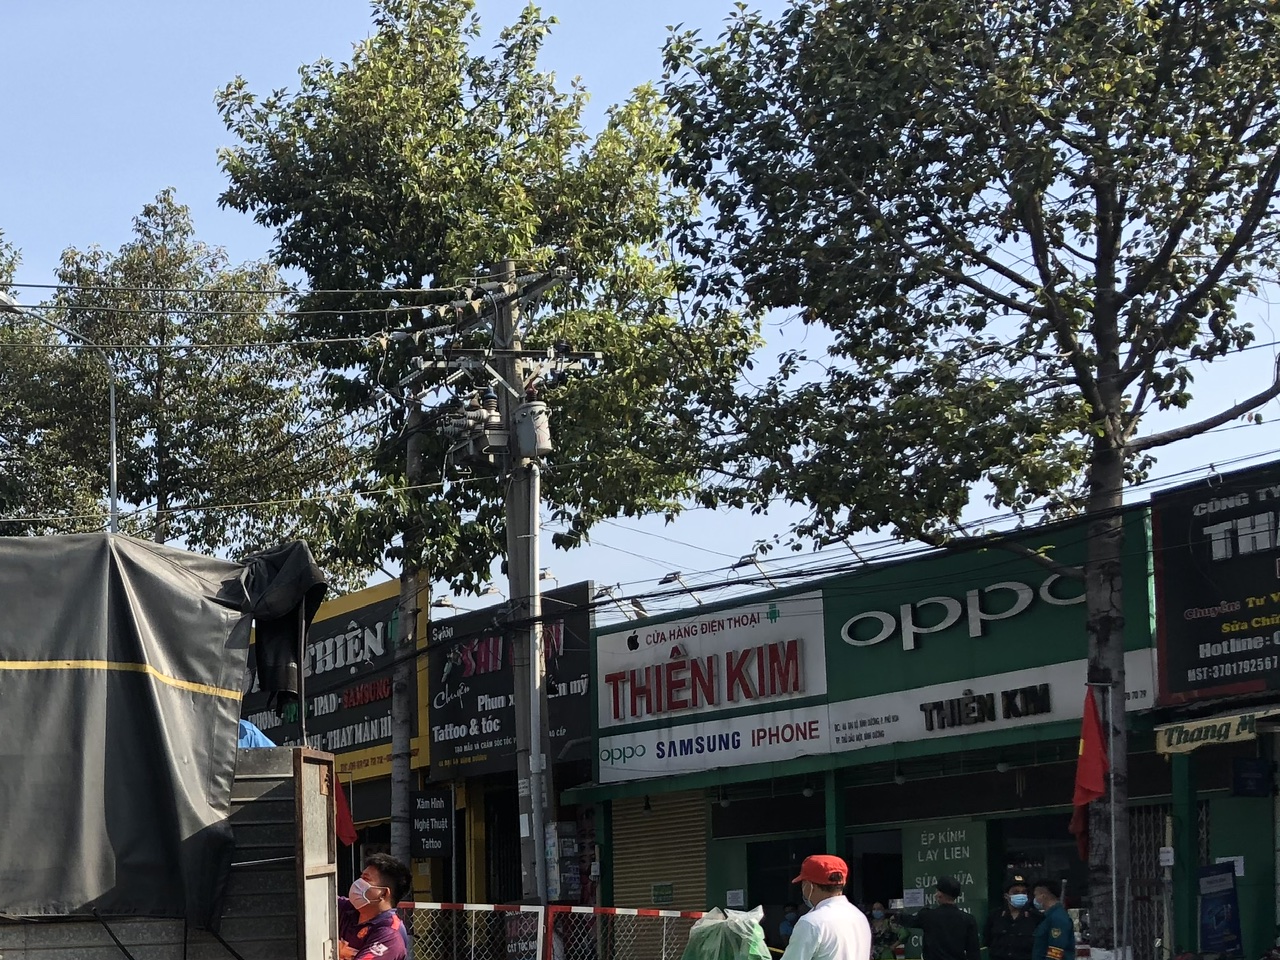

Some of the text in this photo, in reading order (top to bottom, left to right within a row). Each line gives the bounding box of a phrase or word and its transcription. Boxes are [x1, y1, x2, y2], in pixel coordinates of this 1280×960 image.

[1202, 511, 1280, 561] TH
[303, 620, 385, 677] THIỆN
[646, 612, 760, 646] CỬA HÀNG ĐIỆN THOẠI
[605, 644, 718, 720] THIÊN
[726, 638, 805, 702] KIM
[477, 693, 507, 712] Phun
[920, 683, 1051, 731] THIÊN KIM
[432, 723, 467, 743] Tattoo
[481, 715, 501, 733] tóc
[600, 720, 820, 765] oppo SAMSUNG IPHONE
[421, 838, 442, 849] Tattoo
[938, 827, 966, 843] KÍNH
